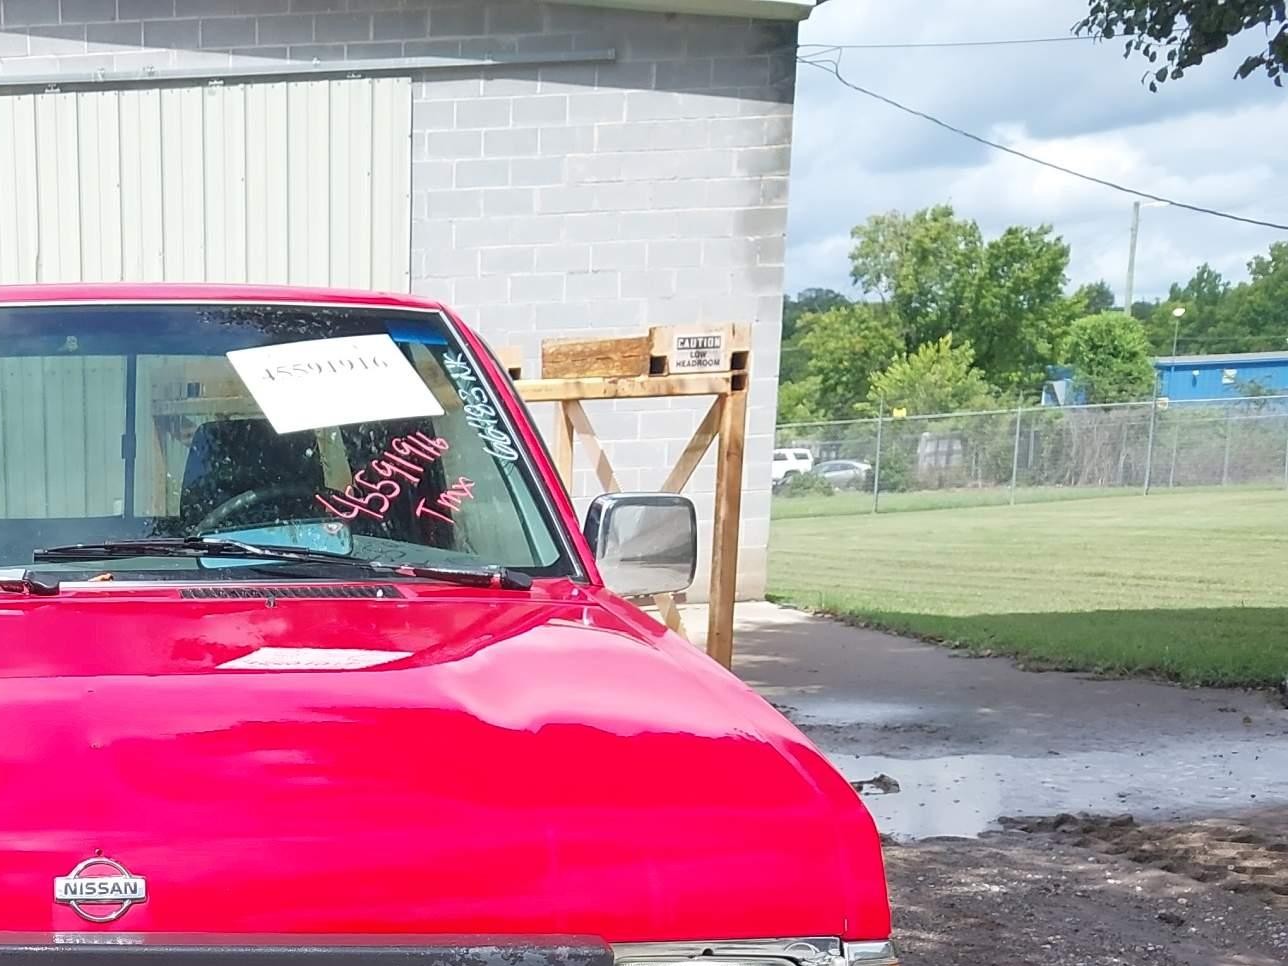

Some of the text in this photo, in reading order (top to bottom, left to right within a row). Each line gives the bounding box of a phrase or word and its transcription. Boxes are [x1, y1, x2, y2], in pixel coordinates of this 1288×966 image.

[677, 337, 720, 349] CAUTION
[690, 350, 708, 359] LOW
[676, 359, 720, 368] HEADROOM
[315, 431, 449, 519] 45591916
[64, 882, 137, 895] NISSAN
